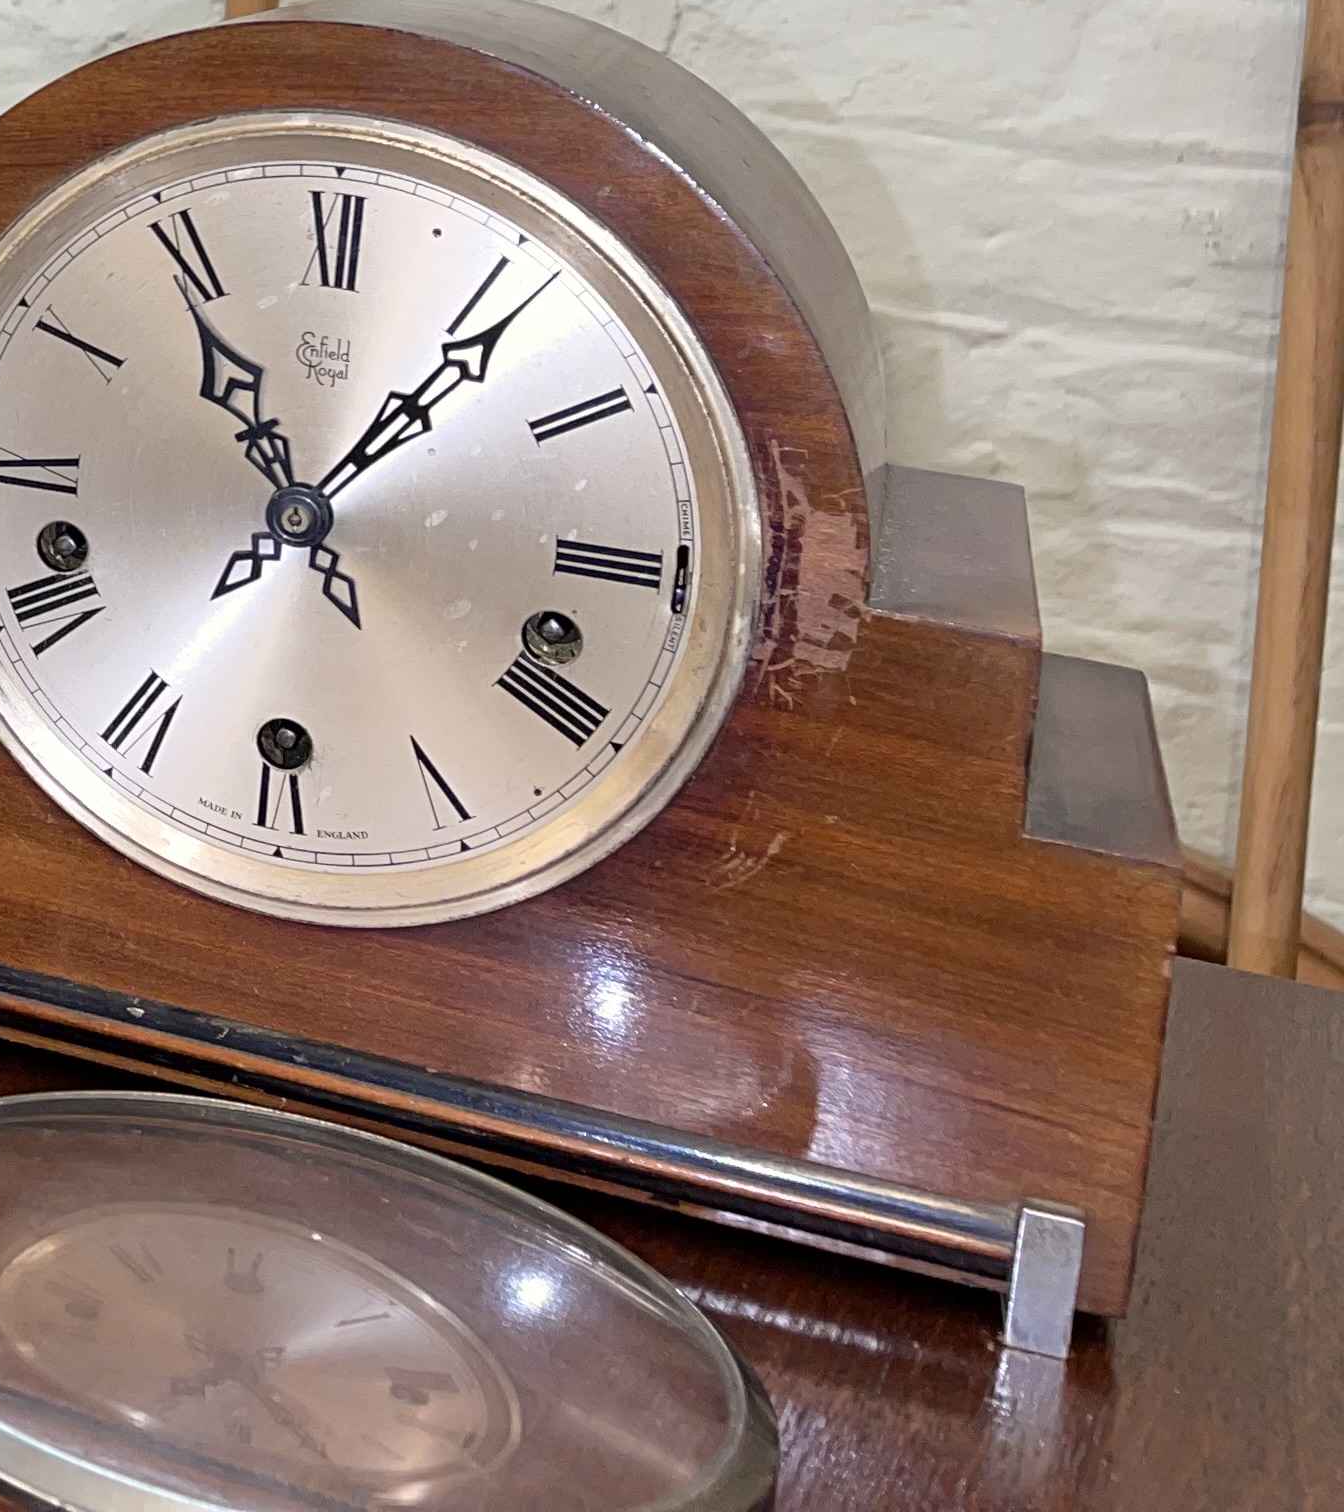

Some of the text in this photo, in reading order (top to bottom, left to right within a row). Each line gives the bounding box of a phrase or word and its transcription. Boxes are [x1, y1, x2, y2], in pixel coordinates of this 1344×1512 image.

[149, 208, 230, 312] XI
[300, 190, 368, 293] XII
[33, 304, 128, 385] X
[296, 331, 350, 368] Enfield
[303, 356, 349, 387] Royal
[526, 384, 635, 449] II
[679, 503, 691, 536] CHIME
[553, 535, 664, 595] III
[6, 569, 106, 659] VIII
[666, 616, 683, 651] SILENT
[97, 668, 183, 778] VII
[410, 734, 477, 832] V
[197, 796, 369, 840] MADE IN ENGLAND
